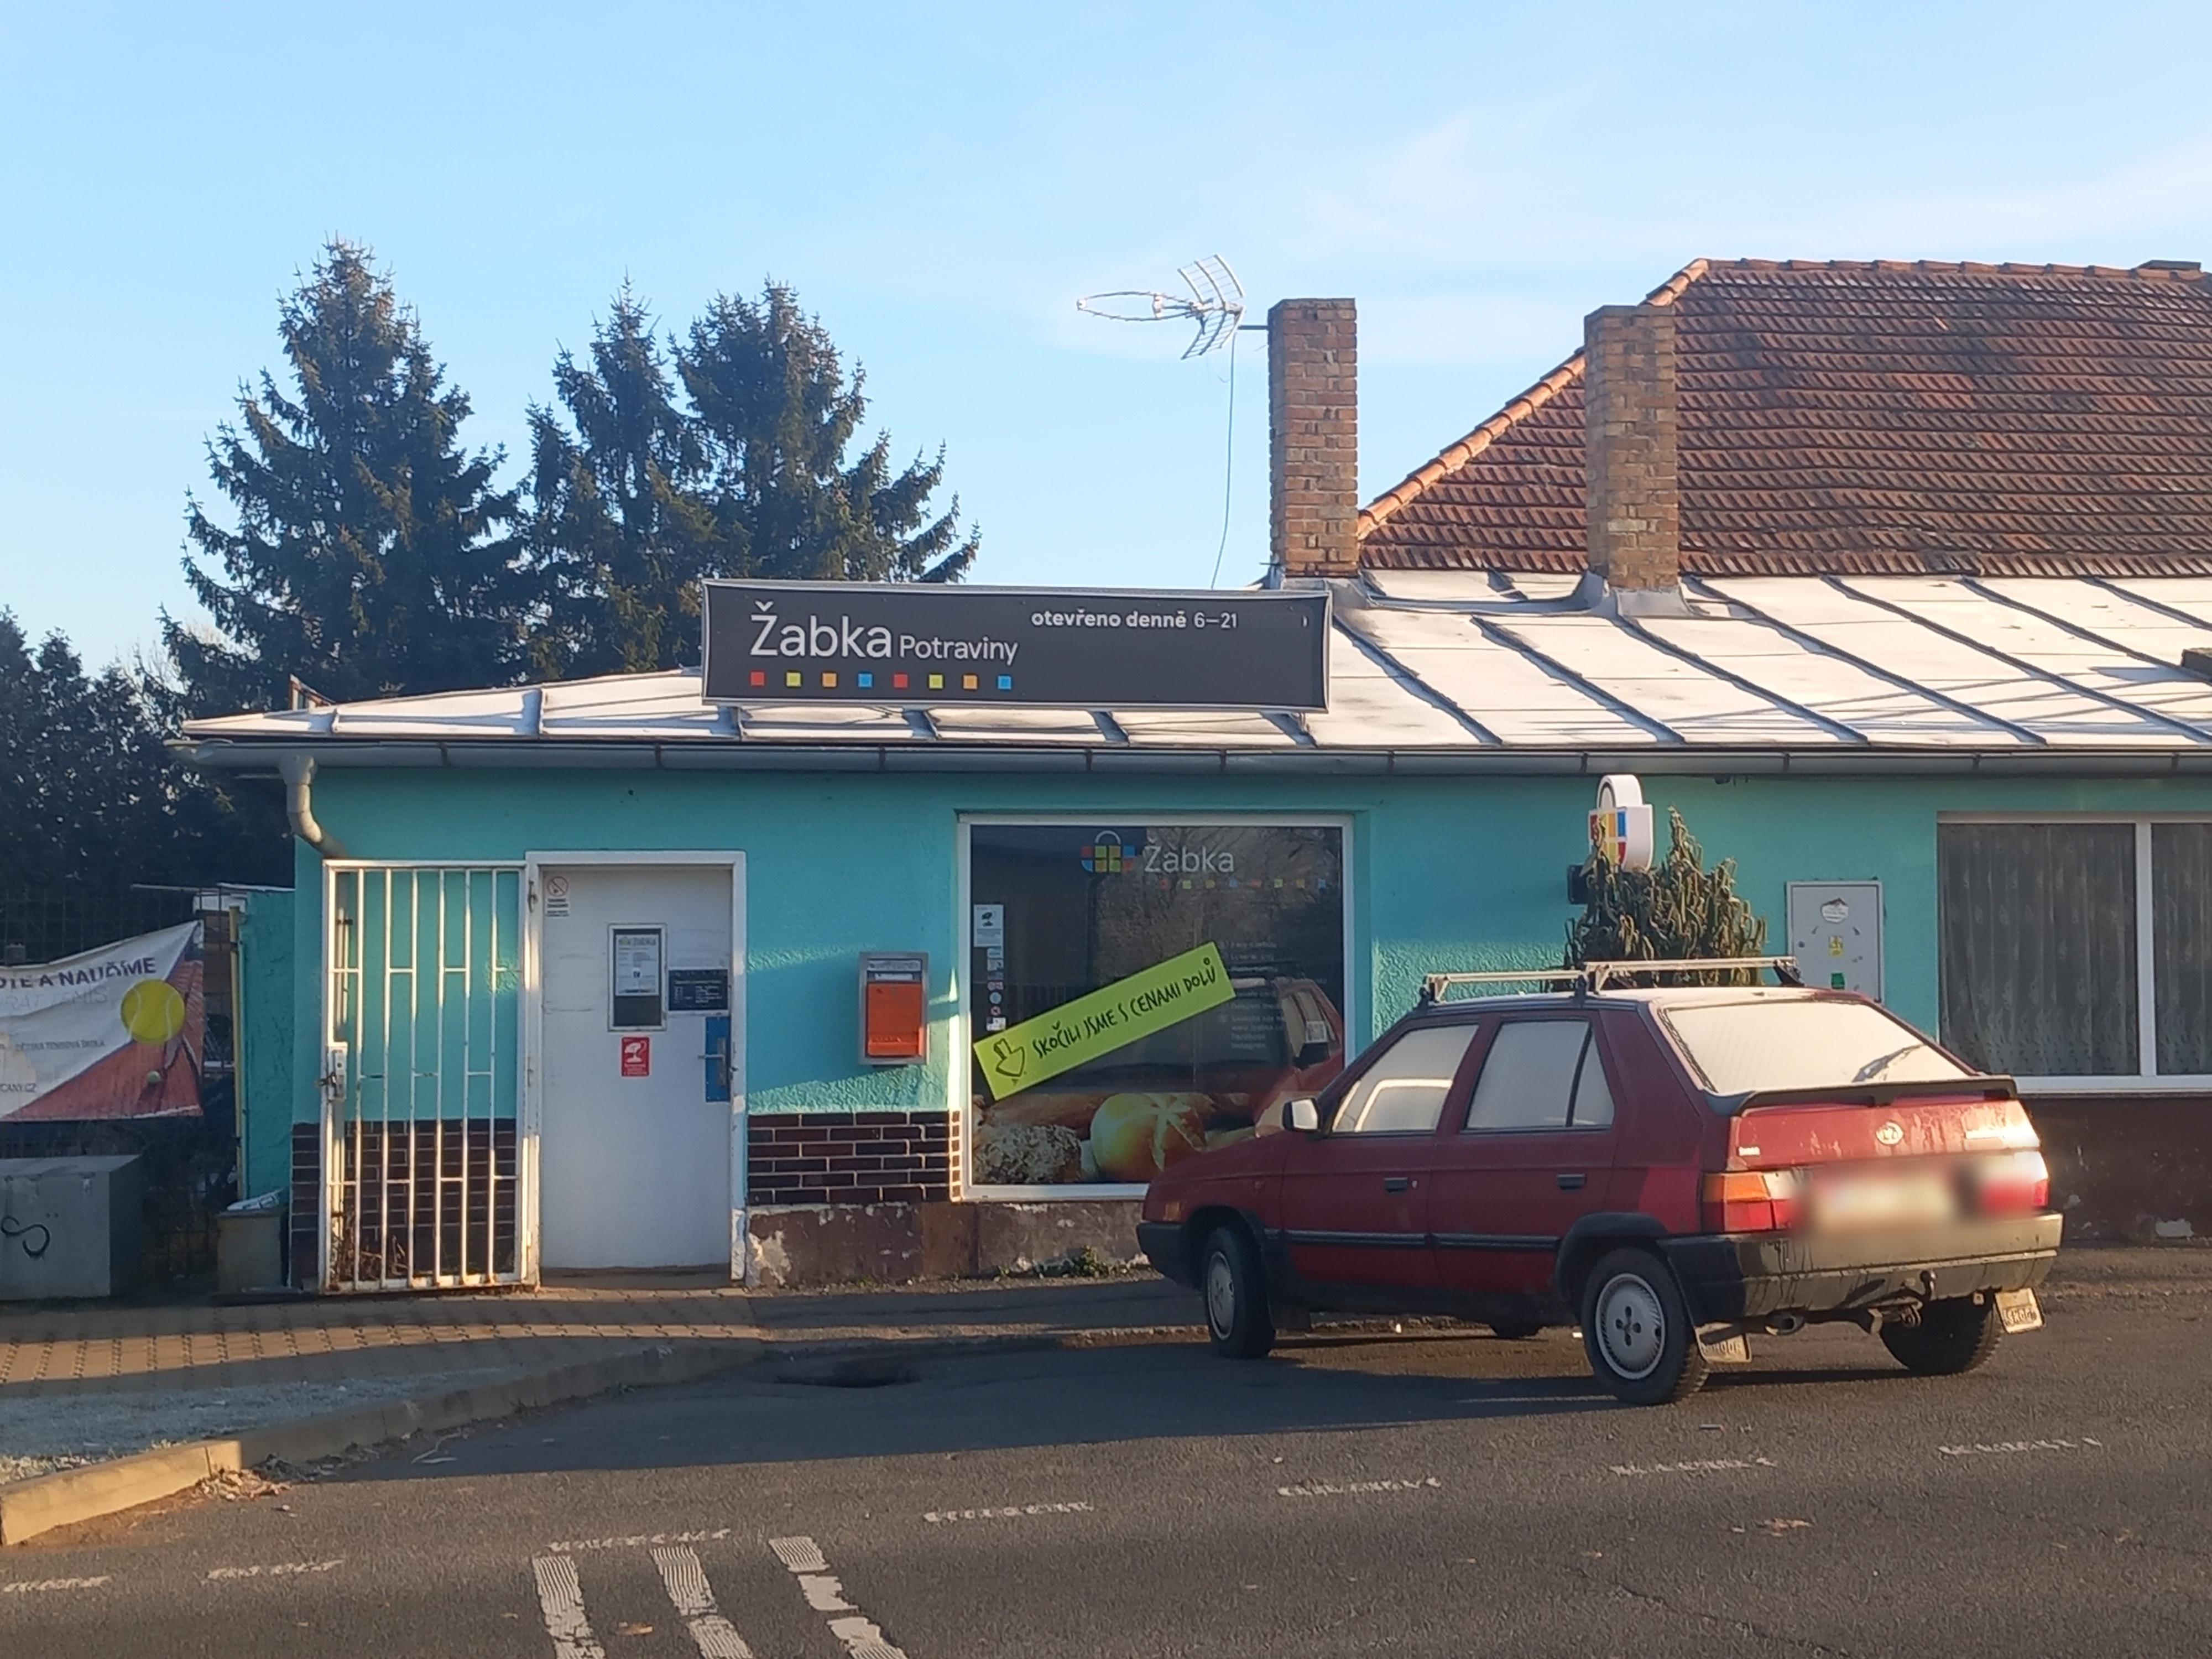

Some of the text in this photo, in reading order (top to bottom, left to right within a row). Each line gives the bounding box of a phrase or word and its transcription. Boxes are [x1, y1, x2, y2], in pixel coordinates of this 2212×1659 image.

[749, 601, 1019, 666] Žabka Potraviny
[1031, 608, 1122, 628] otevřeno
[1125, 611, 1187, 629] denně
[1144, 836, 1235, 873] Žabka
[39, 974, 54, 987] A
[1032, 957, 1216, 1058] SKOČILI JSME S CENAMI DOLŮ
